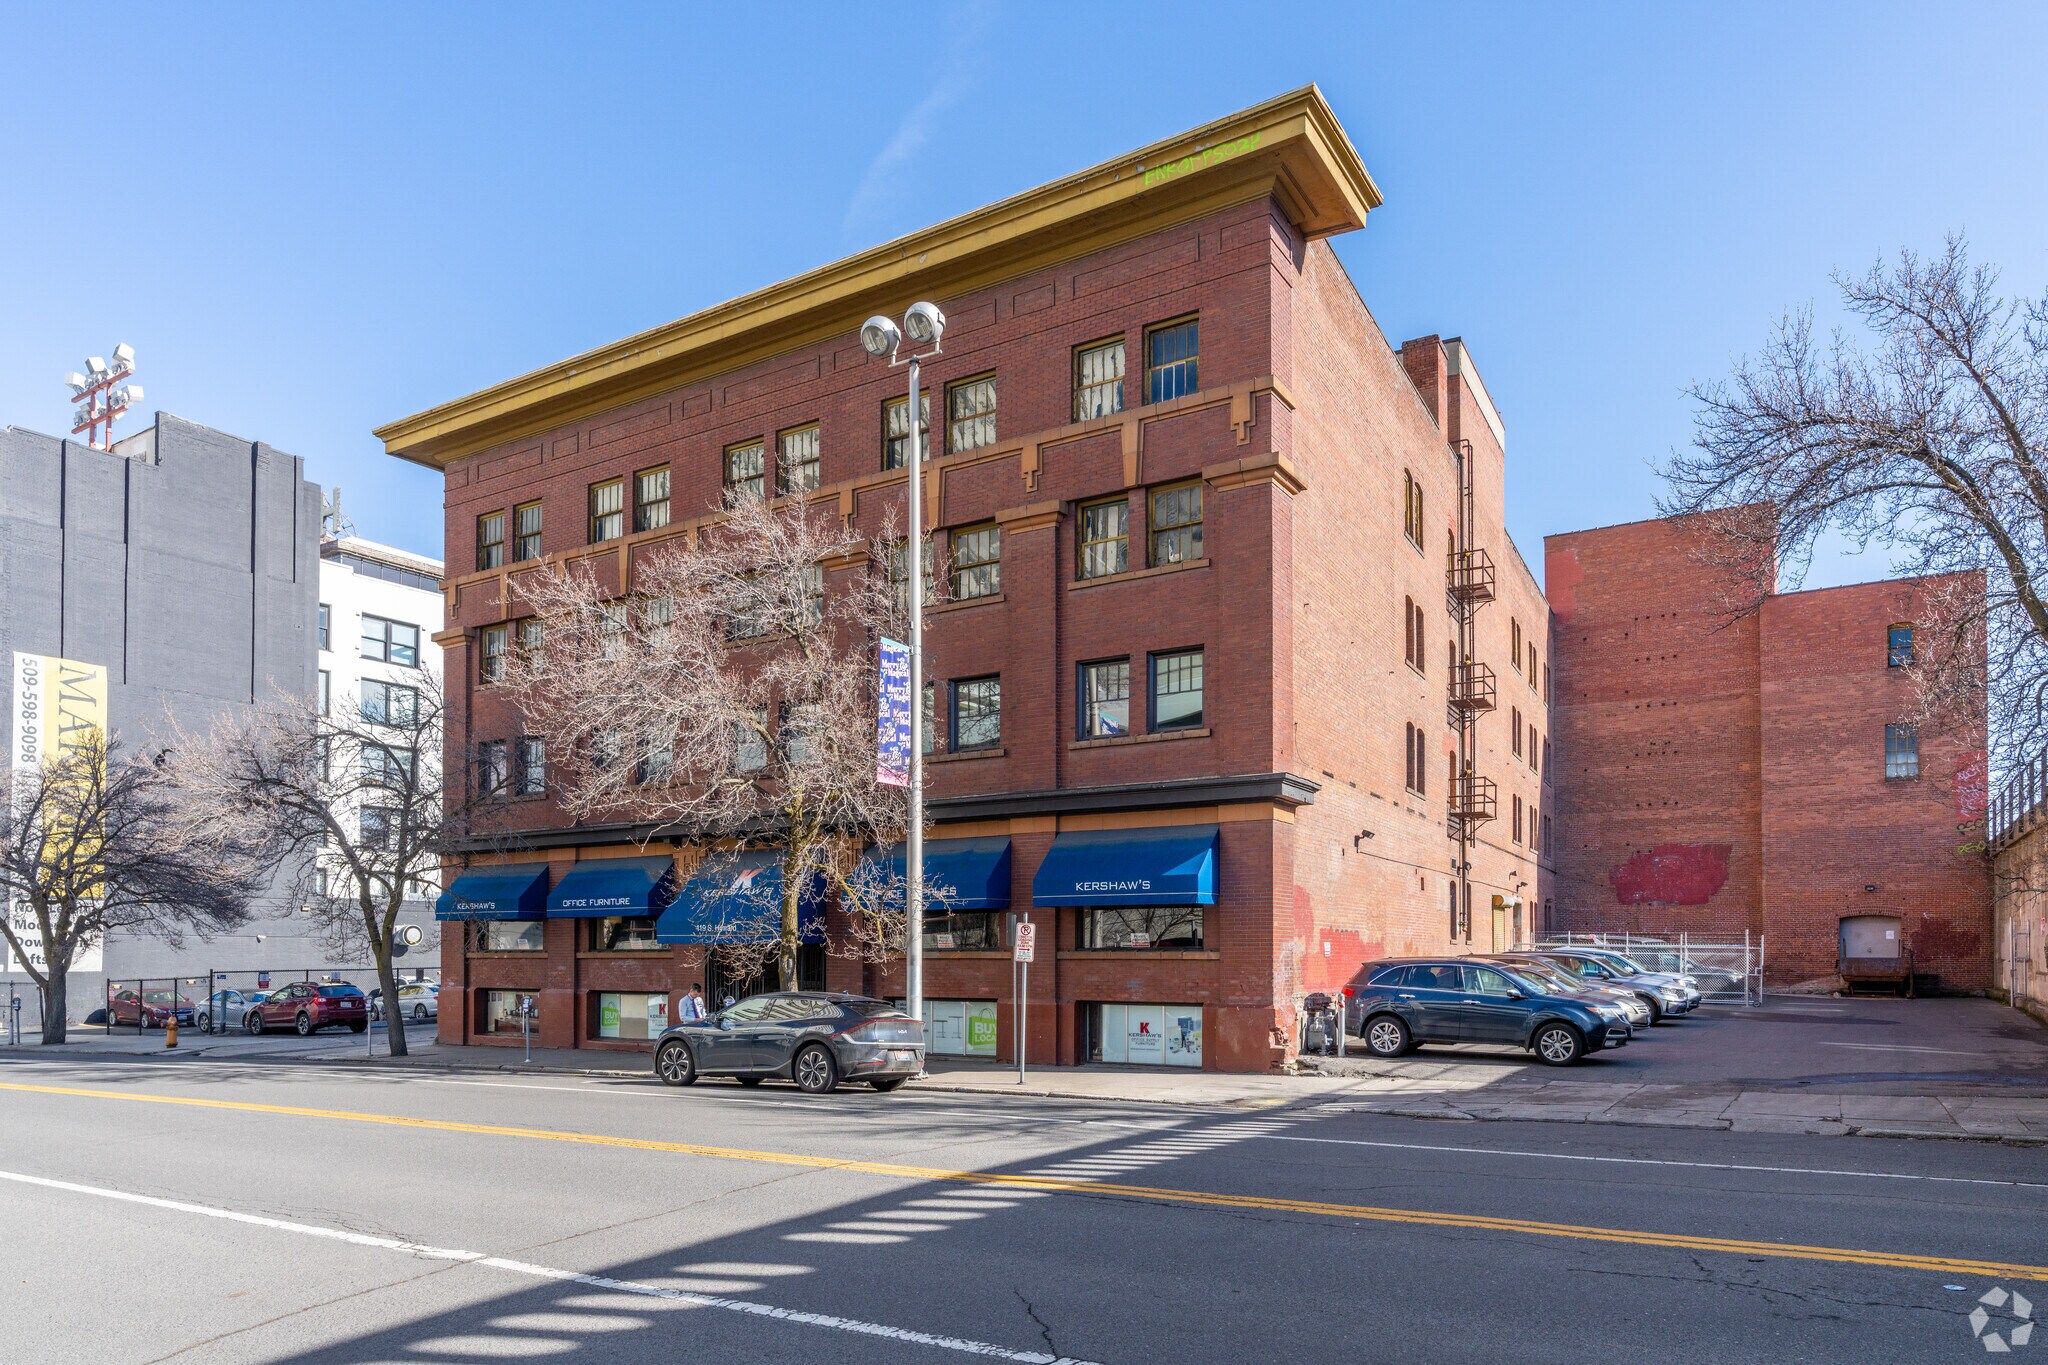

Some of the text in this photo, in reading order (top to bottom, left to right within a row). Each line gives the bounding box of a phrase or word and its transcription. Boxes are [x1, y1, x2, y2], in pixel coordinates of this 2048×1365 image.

[21, 657, 38, 764] 509-598-9098
[1075, 879, 1151, 891] KERSHAW'S
[457, 901, 496, 910] KERSHAW'S
[562, 897, 630, 907] OFFICE FURNITURE
[13, 953, 48, 965] Lfts
[605, 1011, 619, 1019] BUY
[1140, 1022, 1150, 1034] K
